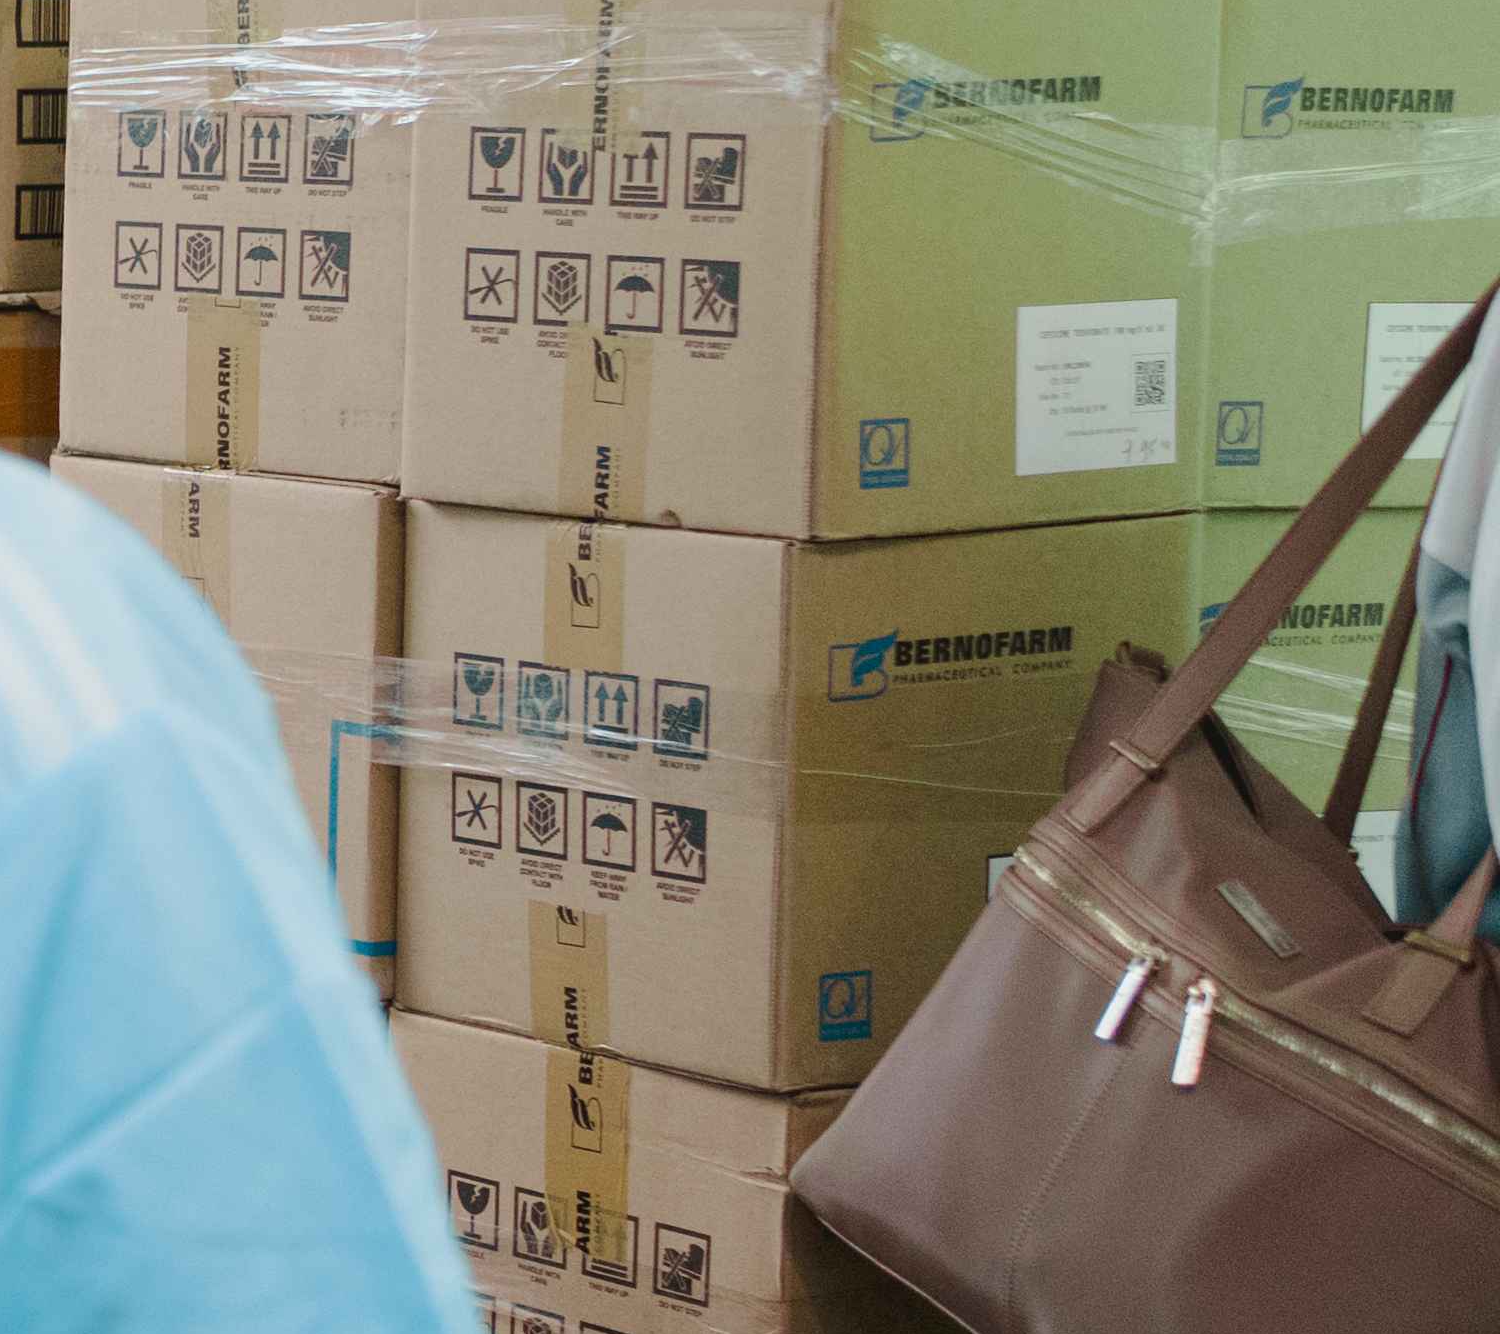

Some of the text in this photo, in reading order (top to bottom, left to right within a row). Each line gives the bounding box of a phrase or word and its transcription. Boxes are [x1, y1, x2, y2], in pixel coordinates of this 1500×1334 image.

[1299, 86, 1456, 115] BERNOFARM
[217, 346, 232, 470] RNOFARM
[1277, 602, 1385, 631] NOFARM
[894, 626, 1073, 668] BERNOFARM
